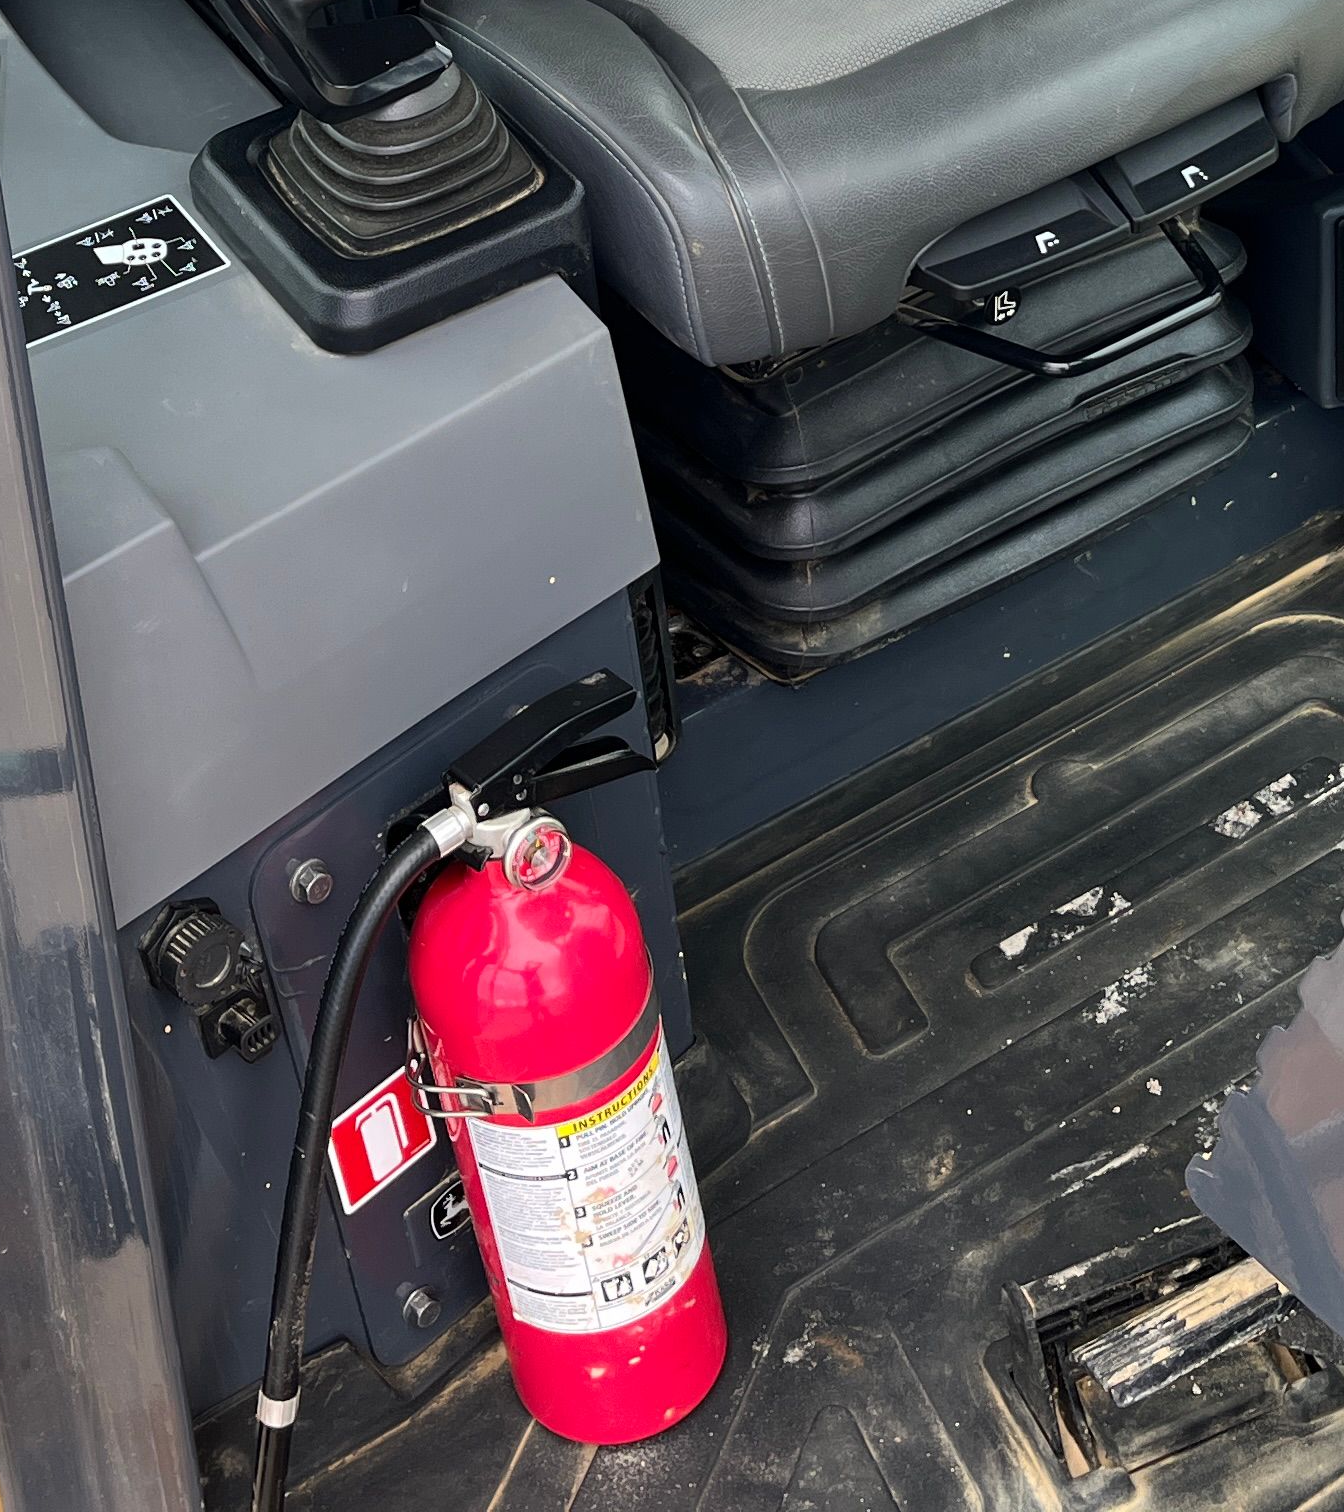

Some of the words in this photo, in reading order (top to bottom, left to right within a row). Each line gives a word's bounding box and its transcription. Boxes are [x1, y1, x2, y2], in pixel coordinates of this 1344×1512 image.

[572, 1066, 654, 1132] INSTRUCTIONS
[609, 1150, 625, 1162] BASE
[626, 1142, 634, 1151] OF
